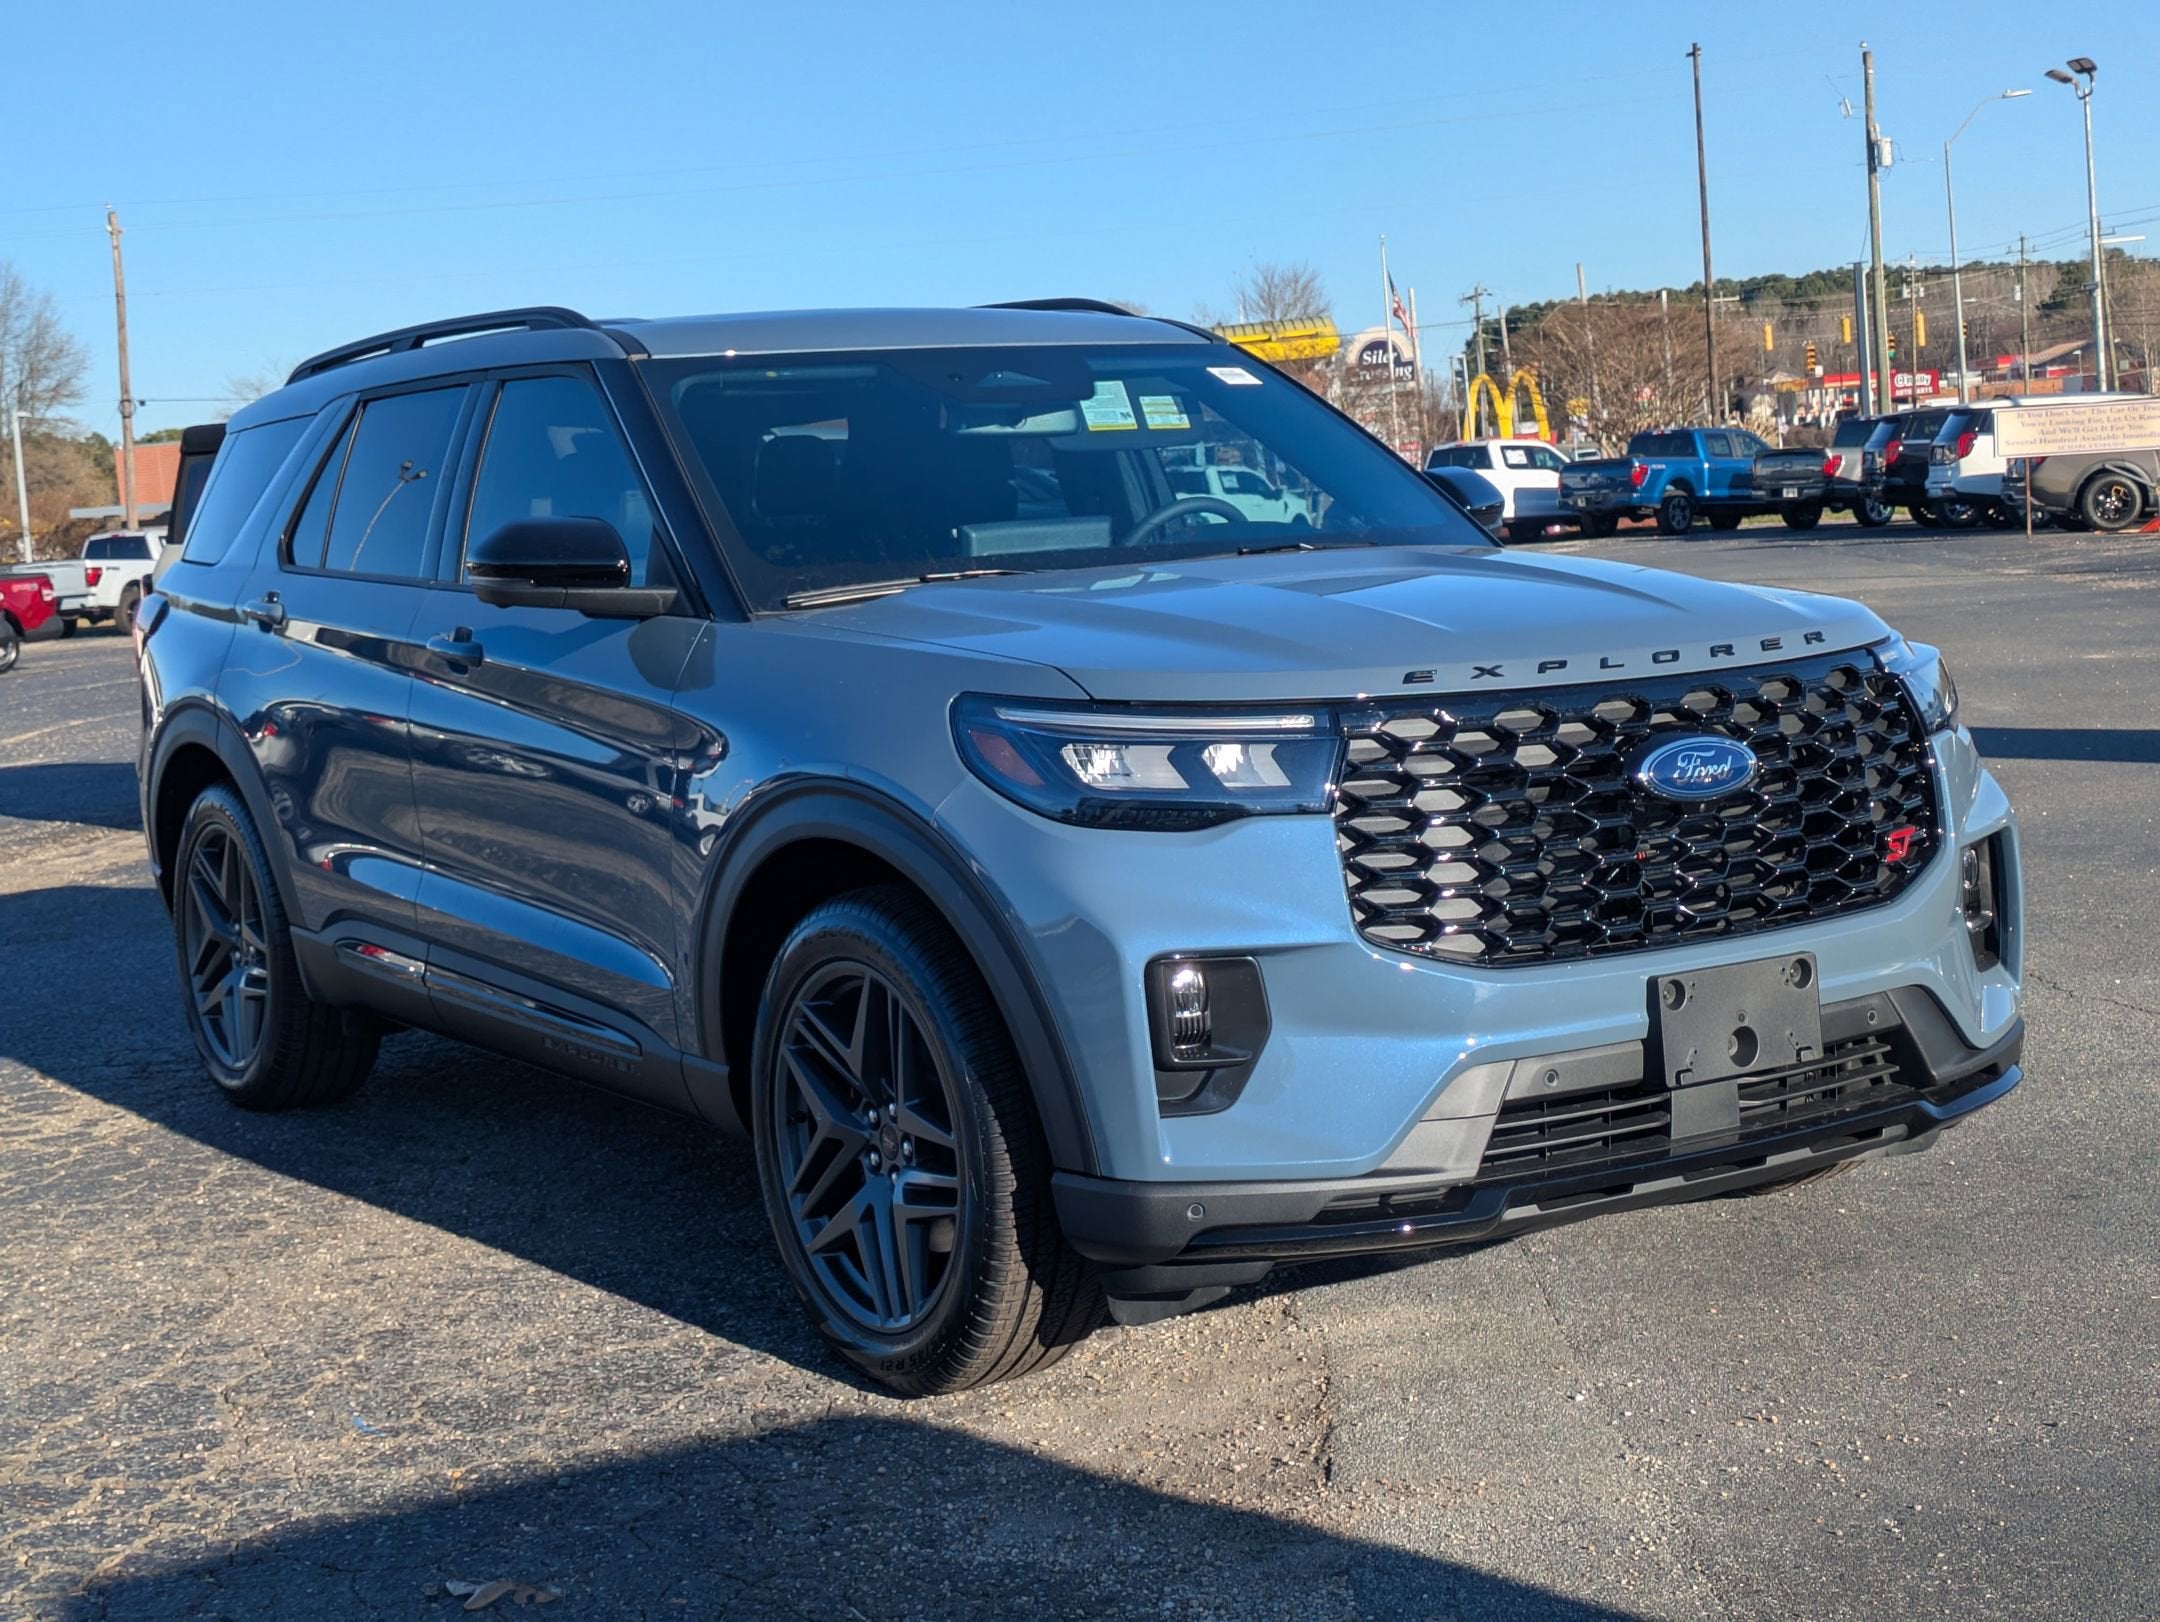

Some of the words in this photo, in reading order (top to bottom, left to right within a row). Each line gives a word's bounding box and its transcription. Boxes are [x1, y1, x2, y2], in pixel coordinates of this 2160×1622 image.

[2027, 411, 2042, 419] You
[2045, 410, 2069, 418] Don't
[2109, 406, 2125, 414] Car
[2020, 420, 2046, 428] You're
[2049, 419, 2085, 427] Looking
[2039, 428, 2056, 436] And
[2082, 425, 2098, 433] Get
[2005, 439, 2037, 447] Several
[2039, 437, 2077, 445] Hundred
[2081, 434, 2120, 442] Available
[1402, 630, 1826, 684] EXPLORER
[1673, 750, 1732, 783] Ford
